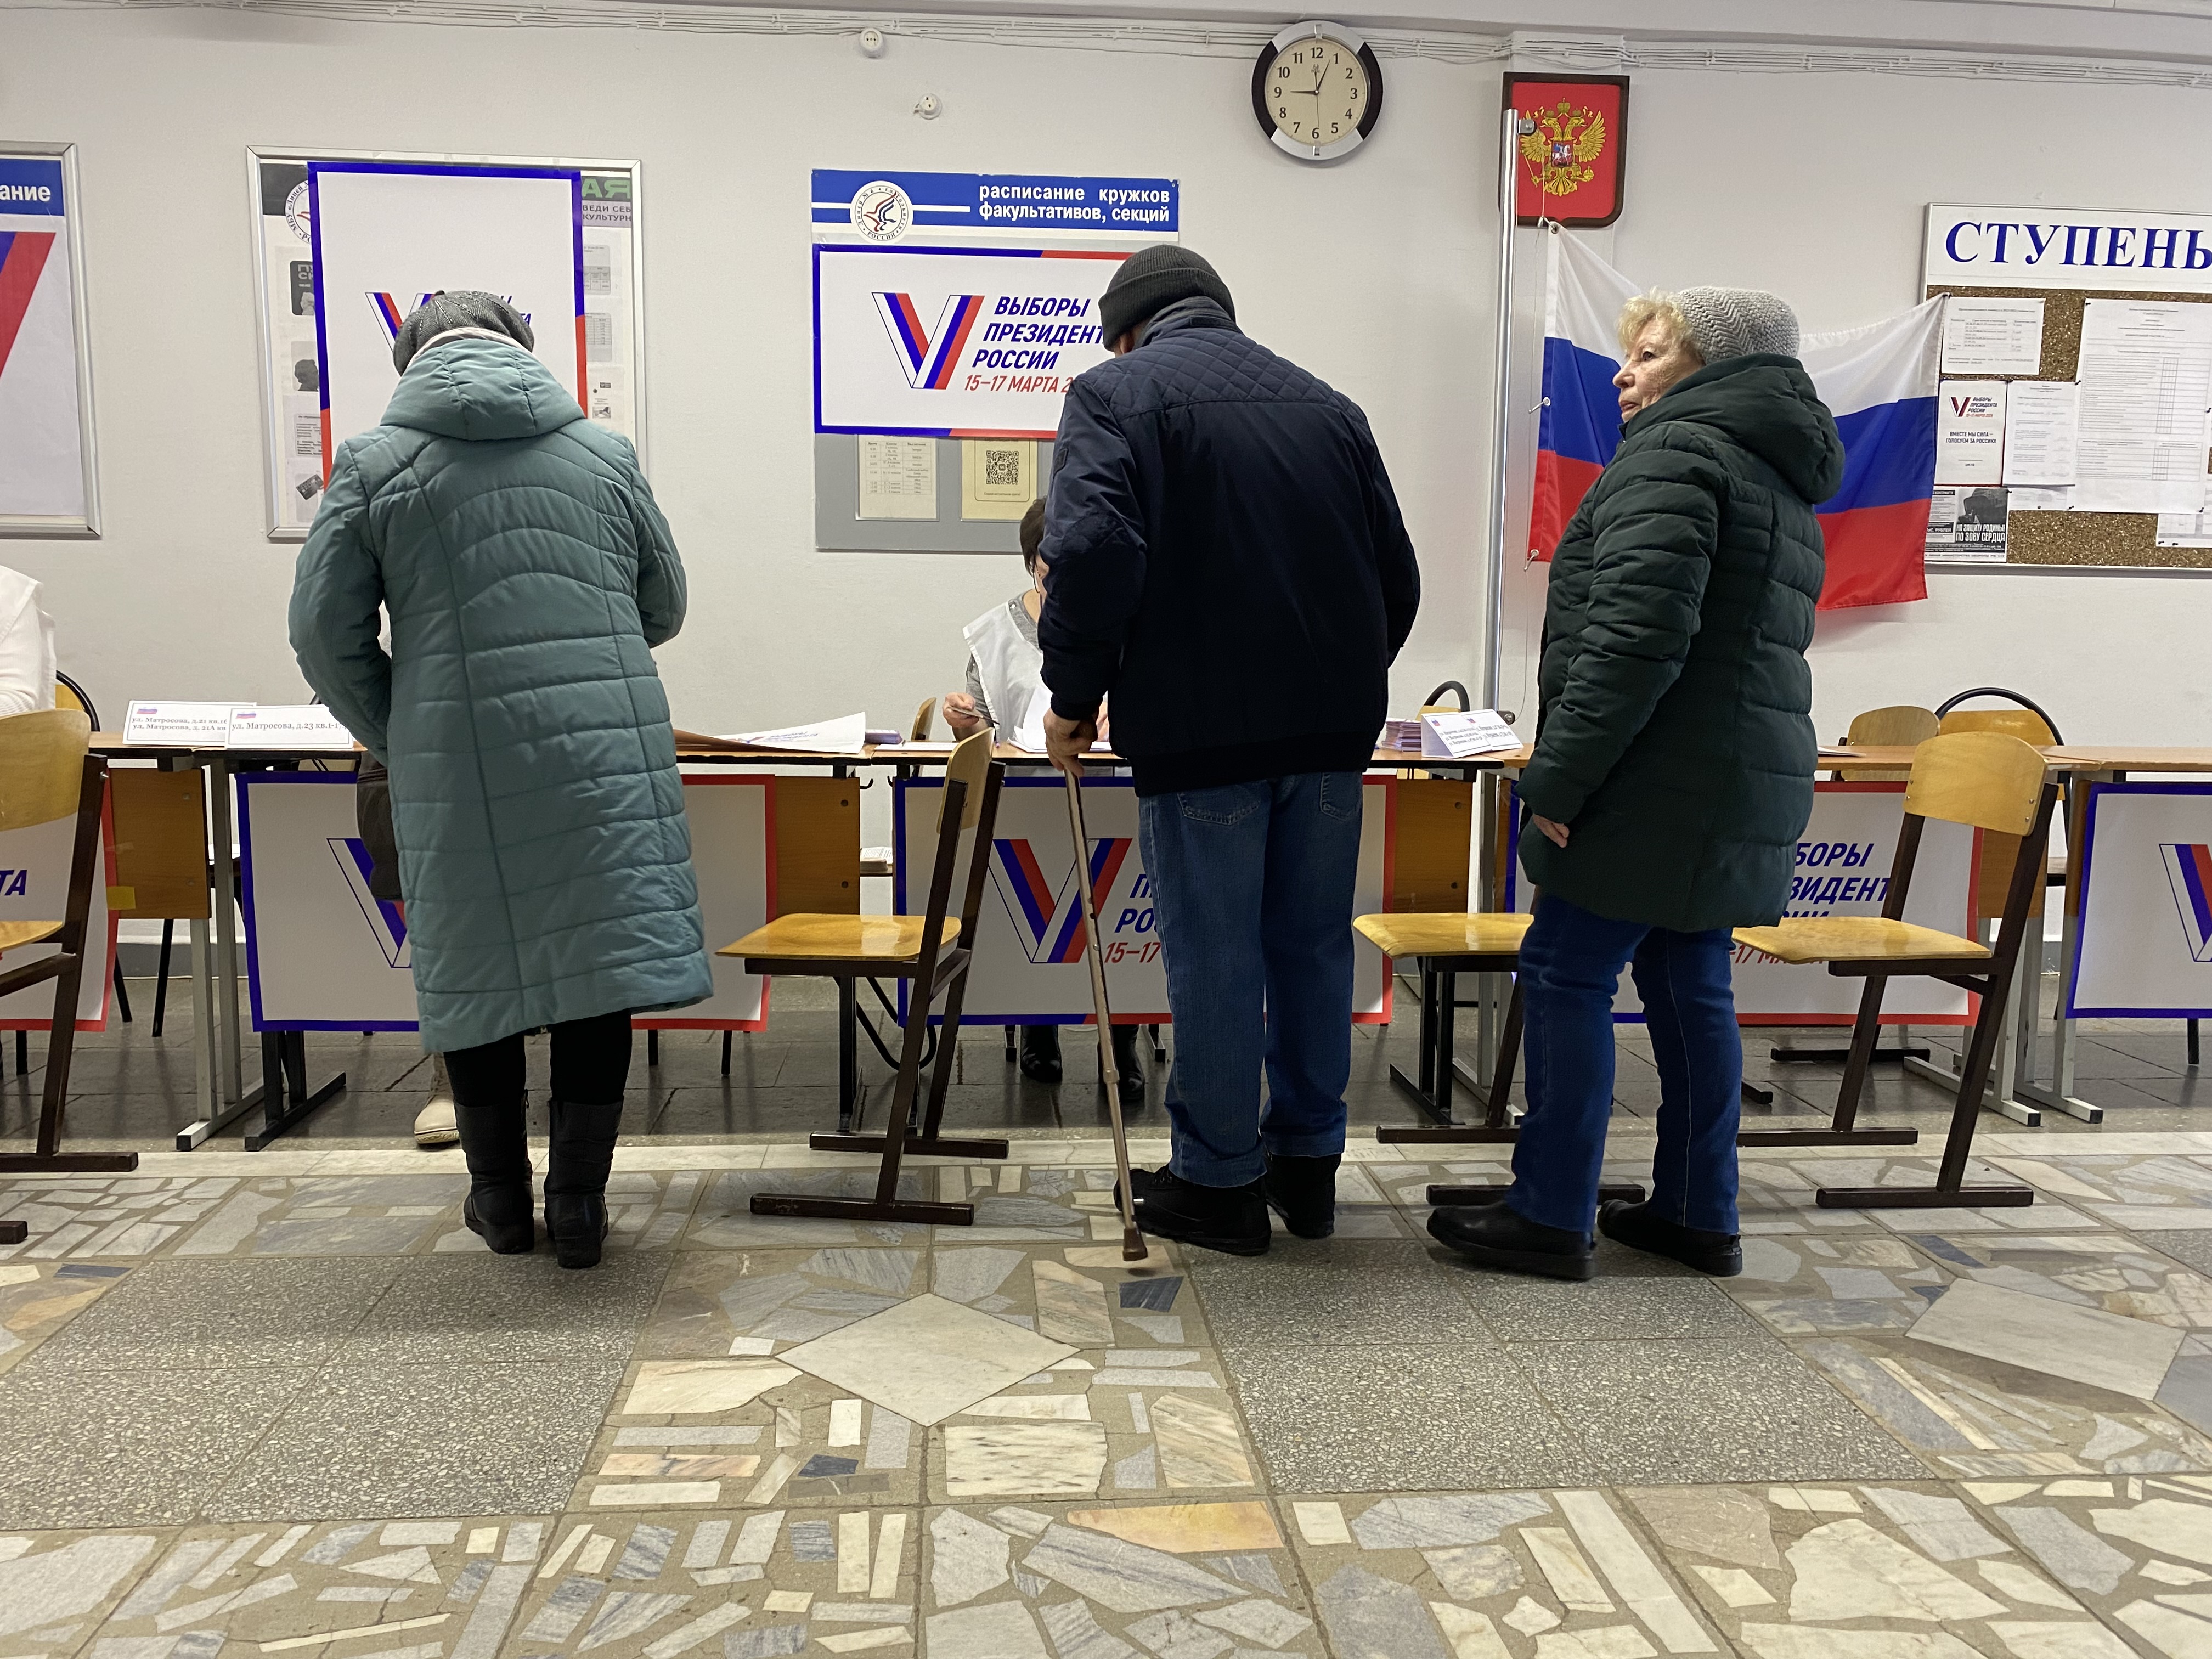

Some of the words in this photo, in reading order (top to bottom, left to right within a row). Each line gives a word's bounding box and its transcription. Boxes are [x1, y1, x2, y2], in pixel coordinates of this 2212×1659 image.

[1292, 53, 1303, 64] 11
[1310, 47, 1323, 59] 12
[1333, 53, 1339, 64] 1
[1277, 66, 1290, 78] 10
[1345, 68, 1353, 79] 2
[1274, 87, 1282, 98] 9
[1350, 88, 1358, 99] 3
[1279, 107, 1286, 118] 8
[1345, 108, 1352, 119] 4
[1293, 122, 1301, 133] 7
[1312, 127, 1319, 139] 6
[1331, 122, 1339, 133] 5
[0, 185, 50, 202] ание
[582, 178, 631, 199] АЯ
[979, 185, 1085, 201] расписание
[1099, 189, 1170, 205] кружков
[979, 201, 1107, 223] факультативов,
[1111, 206, 1170, 224] секций
[867, 231, 895, 240] РОССИЯ
[1945, 221, 2212, 269] СТУПЕНЬ
[994, 296, 1091, 317] ВЫБОРЫ
[983, 323, 1104, 346] ПРЕЗИДЕНТ
[972, 349, 1060, 370] РОССИИ
[1007, 376, 1059, 393] МАРТА
[1963, 524, 1983, 533] ЗАЩИТУ
[1956, 532, 1964, 541] ПО
[1965, 532, 1981, 541] ЗОВУ
[1981, 532, 2005, 543] СЕРДЦА
[246, 722, 295, 730] Матросова,
[1795, 842, 1875, 867] БОРЫ
[1790, 876, 1891, 905] ЗИДЕНТ
